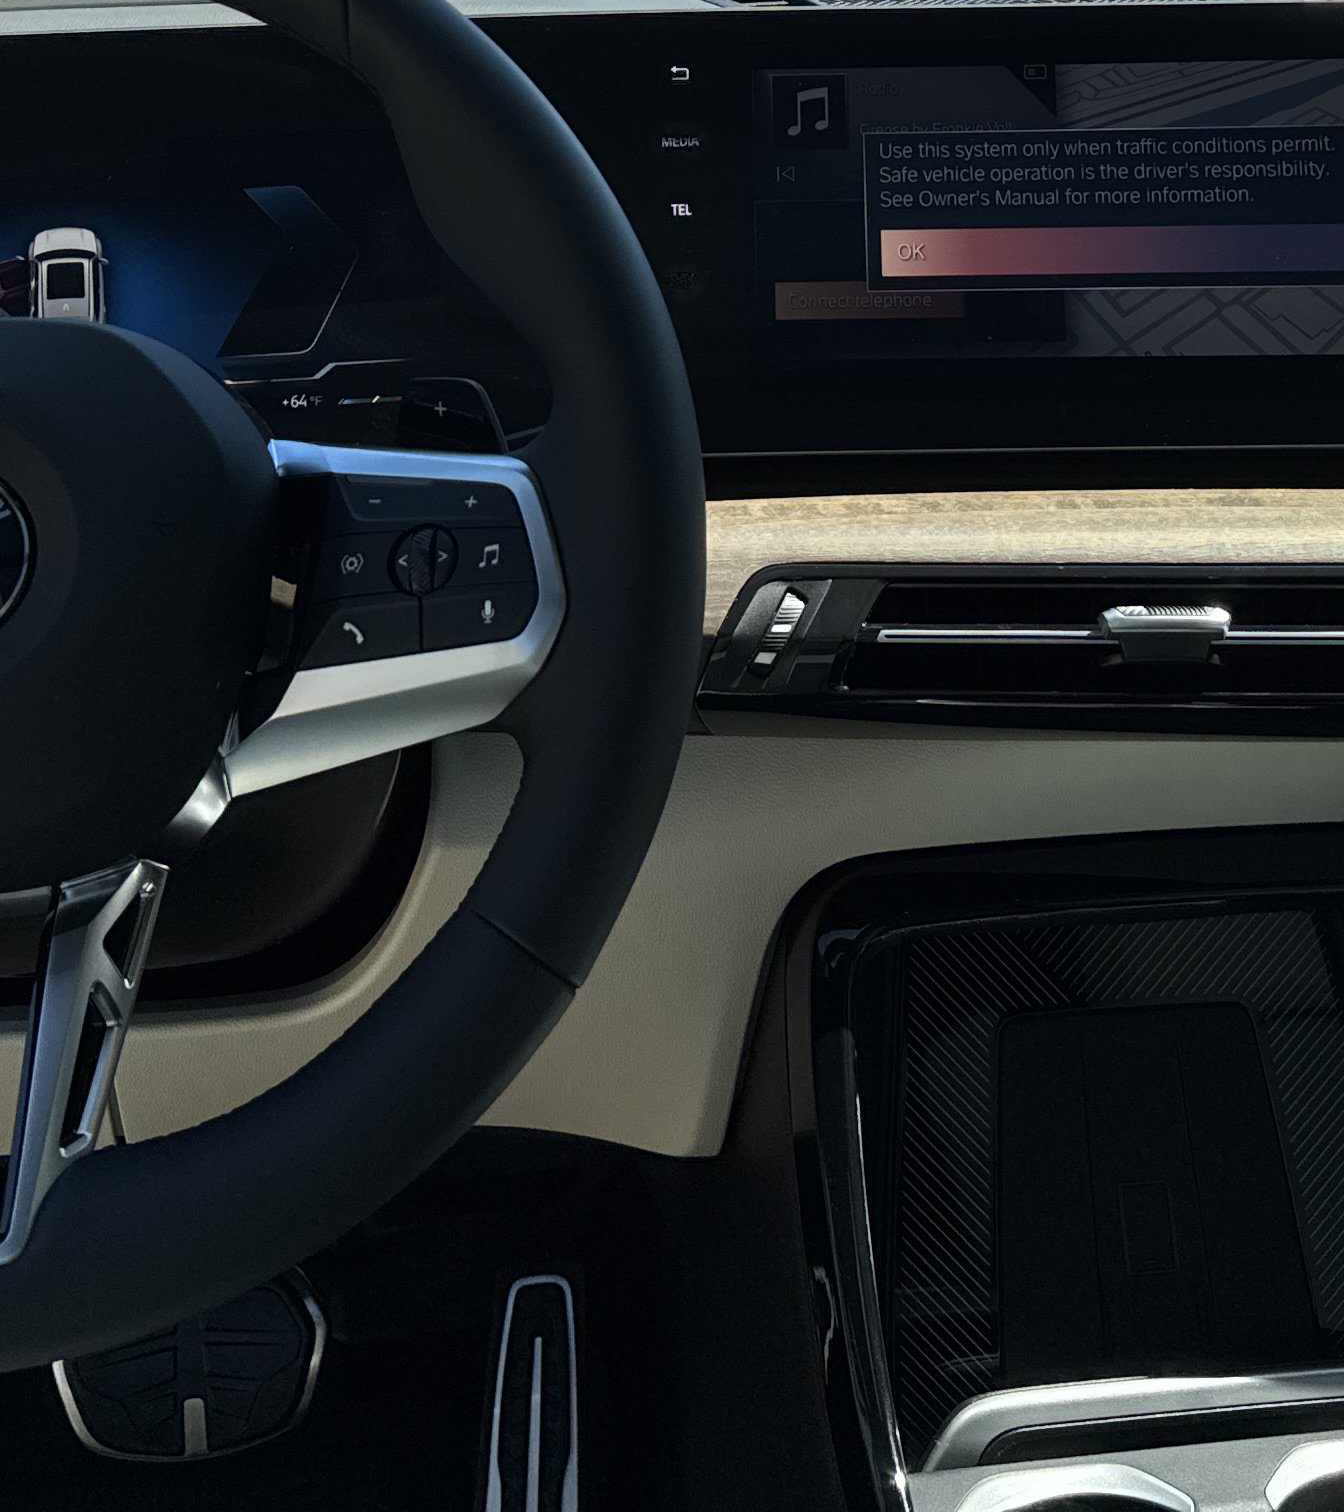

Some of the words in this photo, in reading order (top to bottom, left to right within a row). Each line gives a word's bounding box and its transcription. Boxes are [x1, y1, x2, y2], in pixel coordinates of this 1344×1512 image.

[879, 142, 913, 159] Use
[918, 142, 950, 158] this
[955, 143, 1017, 161] system
[1022, 140, 1060, 160] only
[1064, 139, 1111, 156] when
[1116, 137, 1168, 155] traffic
[1172, 137, 1266, 155] conditions
[1271, 136, 1336, 156] permit.
[879, 166, 918, 183] Safe
[922, 165, 985, 183] vehicle
[990, 165, 1075, 184] operation
[1081, 164, 1095, 180] is
[1100, 163, 1129, 180] the
[1134, 163, 1200, 179] driver's
[1205, 160, 1330, 181] responsibility.
[880, 191, 914, 208] See
[918, 190, 991, 207] Owner's
[995, 189, 1059, 206] Manual
[1065, 188, 1090, 205] for
[1095, 190, 1141, 205] more
[1146, 186, 1255, 203] information.
[671, 203, 693, 217] TEL
[899, 243, 927, 261] OK
[788, 293, 849, 309] Connect
[855, 294, 932, 309] telephone
